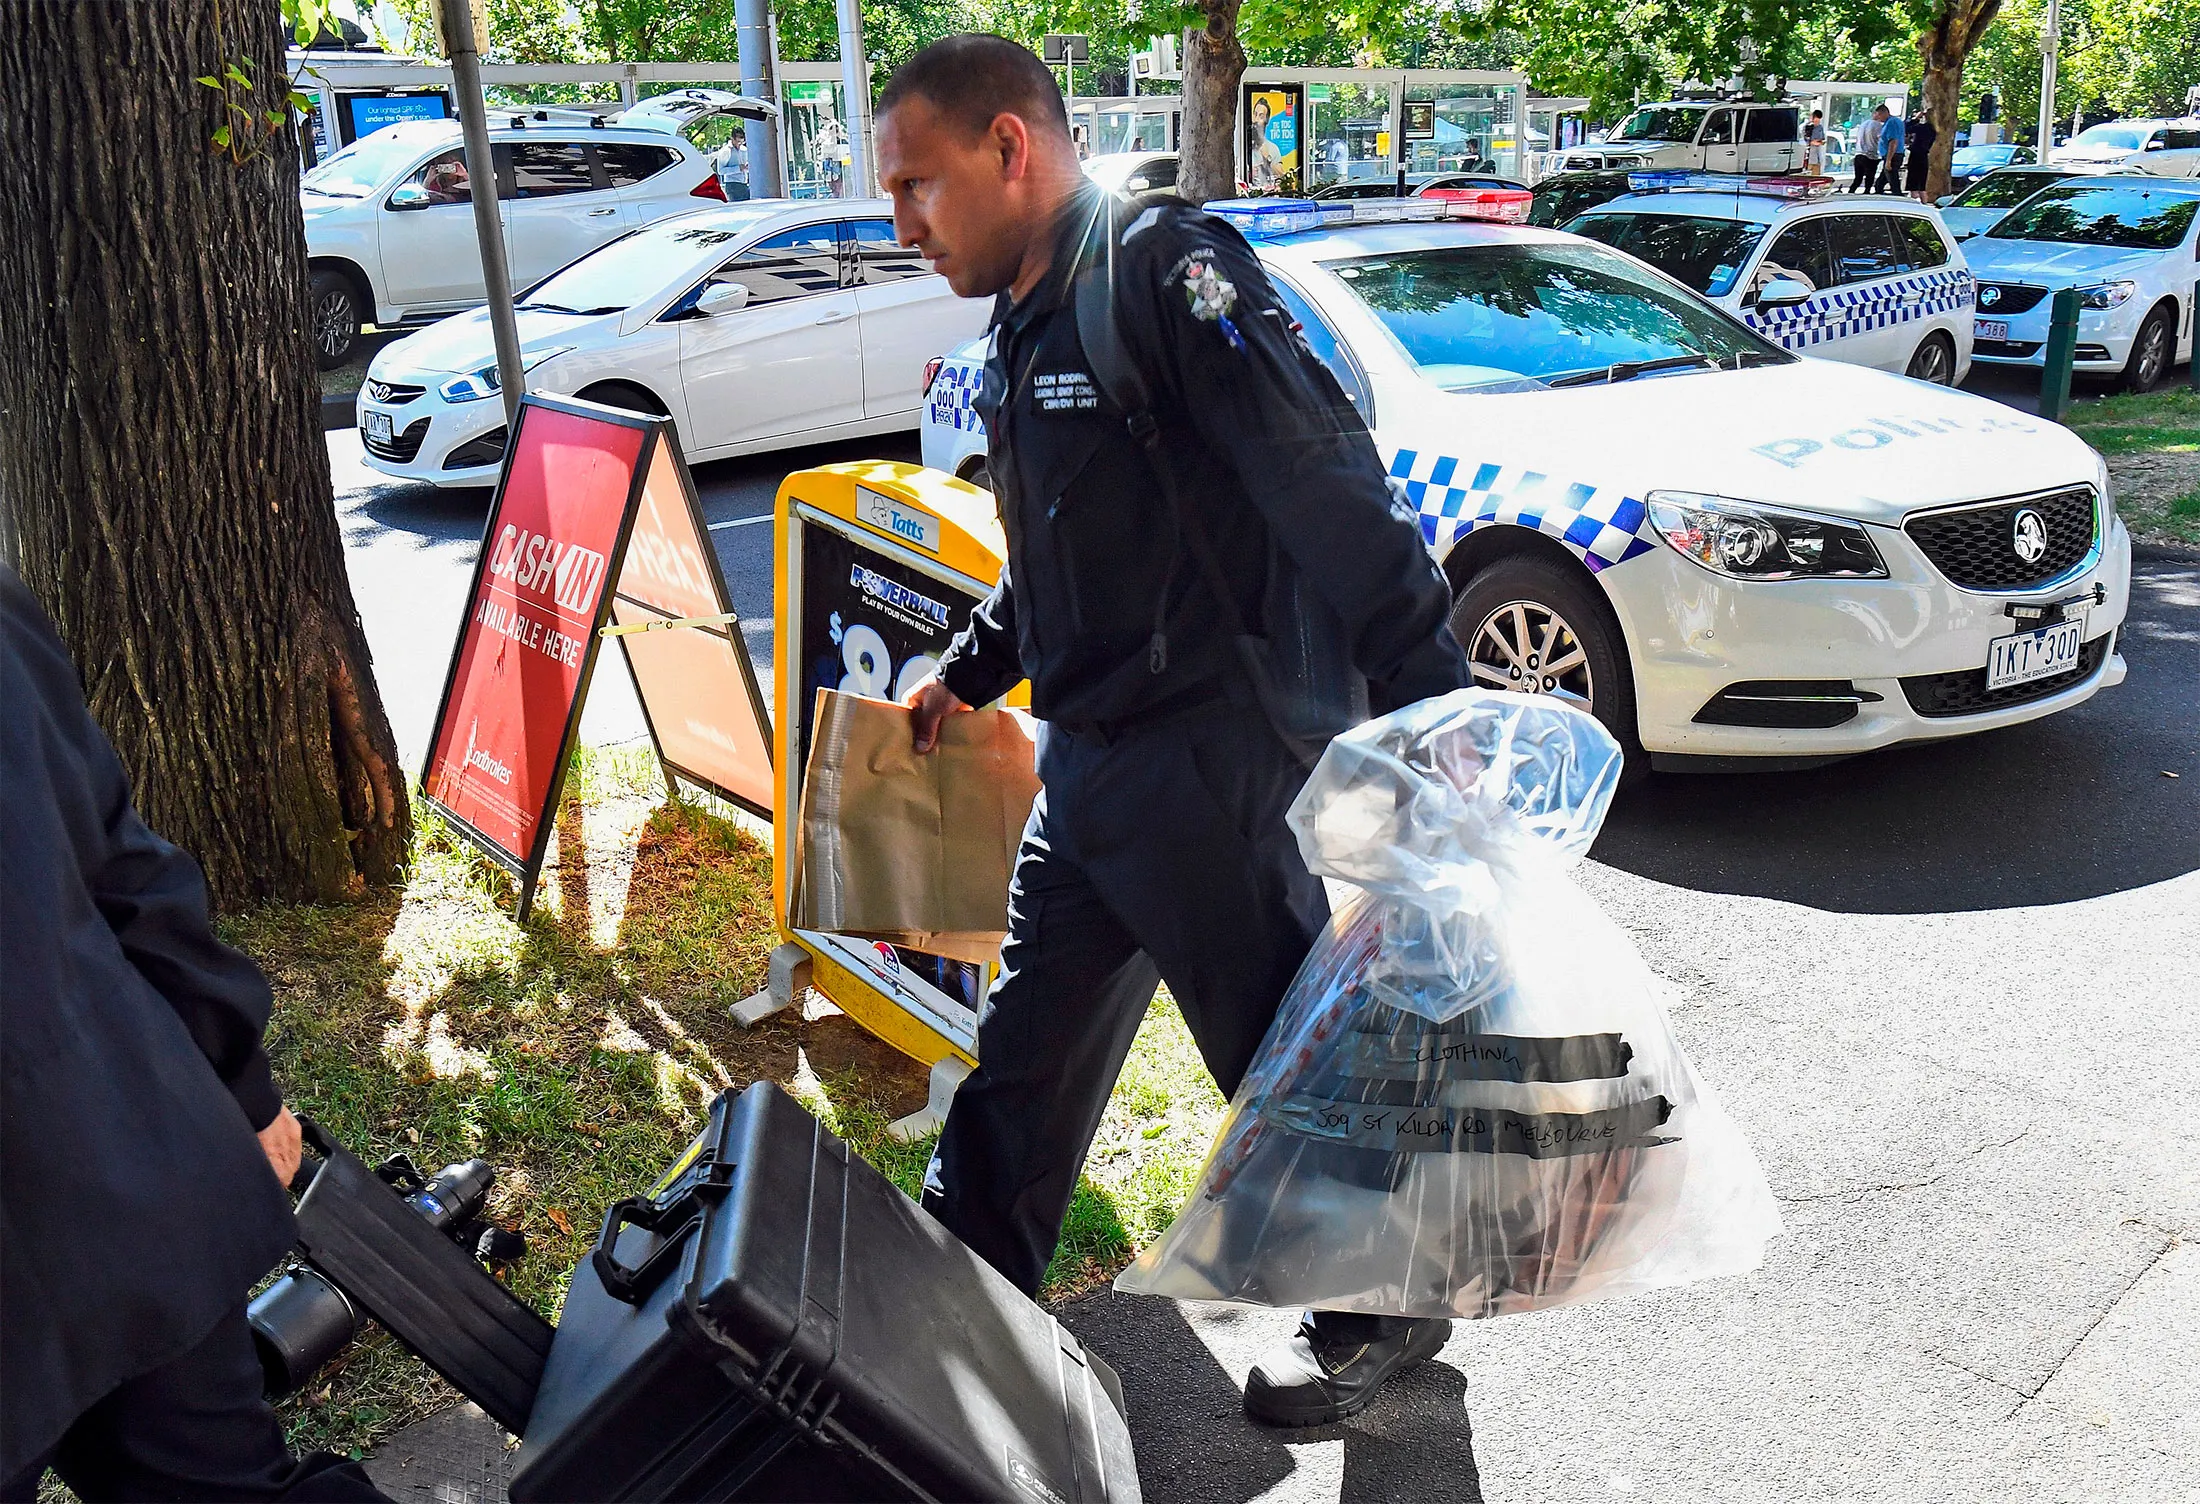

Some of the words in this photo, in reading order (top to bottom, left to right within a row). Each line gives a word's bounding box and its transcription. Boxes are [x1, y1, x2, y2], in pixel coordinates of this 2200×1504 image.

[1985, 324, 2006, 336] 388
[1034, 375, 1056, 386] LEON
[937, 389, 954, 409] 000
[890, 509, 924, 541] Tatts
[490, 523, 564, 595] CASH
[558, 547, 602, 614] IN
[850, 563, 949, 630] POWERBALL
[861, 595, 876, 609] PLAY
[876, 602, 885, 611] BY
[884, 605, 900, 621] YOUR
[900, 614, 915, 627] OWN
[914, 620, 934, 636] RULES
[476, 598, 543, 650] AVAILABLE
[541, 628, 582, 668] HERE
[1992, 676, 2017, 685] VICTORIA
[2032, 665, 2059, 677] EDUCATION
[2060, 661, 2073, 669] STATE
[1996, 640, 2032, 676] 1KT
[466, 738, 512, 785] Ladbrokes
[1415, 1042, 1522, 1072] CLOTHING
[1363, 1111, 1391, 1131] ST
[1396, 1111, 1454, 1137] KILDA
[1463, 1116, 1486, 1135] RD
